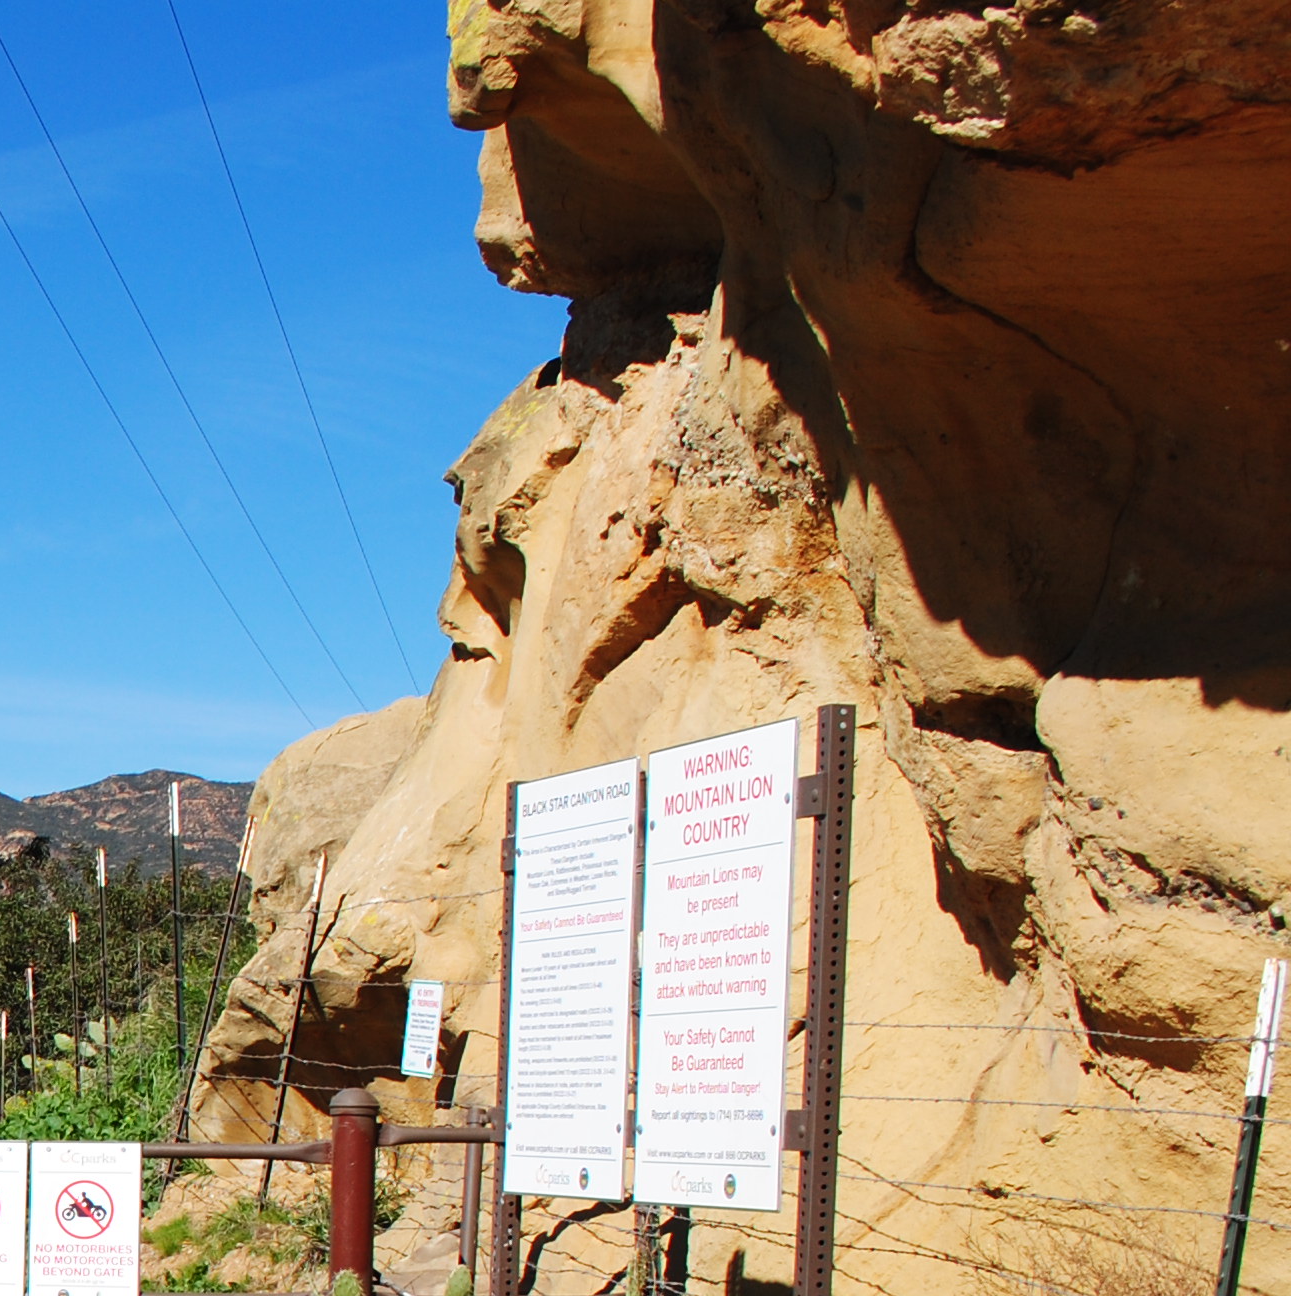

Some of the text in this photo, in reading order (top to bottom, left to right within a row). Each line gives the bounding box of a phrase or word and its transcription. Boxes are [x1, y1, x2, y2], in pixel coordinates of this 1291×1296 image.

[684, 746, 752, 780] WARNING:
[522, 782, 630, 817] BLACK STAR CANYON ROAD
[664, 774, 773, 816] MOUNTAIN LION
[683, 813, 750, 845] COUNTRY
[668, 865, 763, 891] Mountain Lions may
[687, 892, 739, 916] be present
[521, 910, 624, 932] Your Safety Cannot Be Guaranteed
[658, 921, 769, 951] They are unpredictable
[655, 948, 771, 974] and have been known to
[657, 975, 767, 999] attack without warning
[664, 1026, 755, 1048] Your Safety Cannot
[672, 1053, 744, 1071] Be Guaranteed
[655, 1081, 761, 1098] Stay Alert to Potential Danger!
[651, 1110, 671, 1122] Report
[681, 1110, 708, 1123] sightings
[709, 1111, 715, 1120] to
[60, 1150, 117, 1166] OCparks
[737, 1152, 766, 1160] OCPARKS
[671, 1171, 713, 1196] OCparks
[35, 1243, 133, 1254] NO MOTORBIKES
[33, 1255, 134, 1266] NO MOTORCYCES
[43, 1267, 124, 1277] BEYOND GATE
